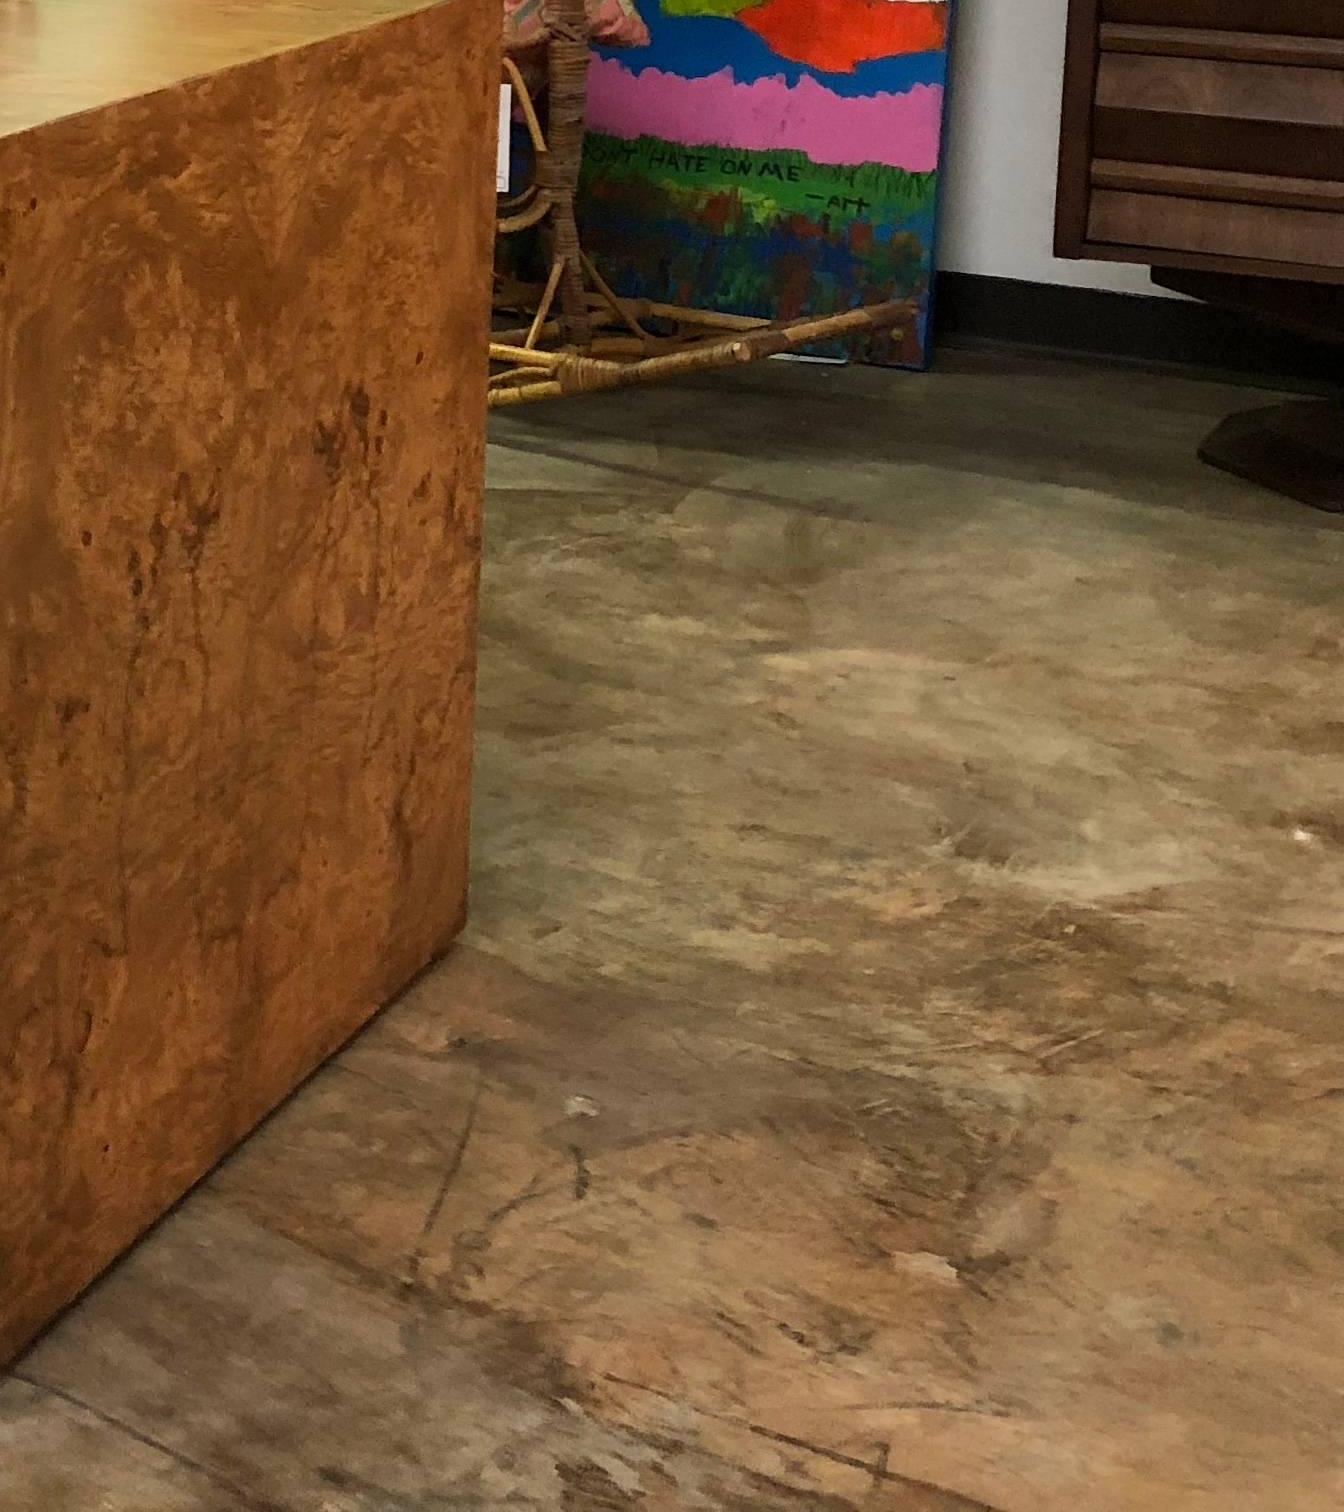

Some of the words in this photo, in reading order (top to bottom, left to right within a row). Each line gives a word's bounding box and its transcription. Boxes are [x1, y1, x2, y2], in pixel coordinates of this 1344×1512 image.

[648, 150, 712, 173] HATE
[719, 159, 752, 176] ON
[758, 165, 802, 183] ME
